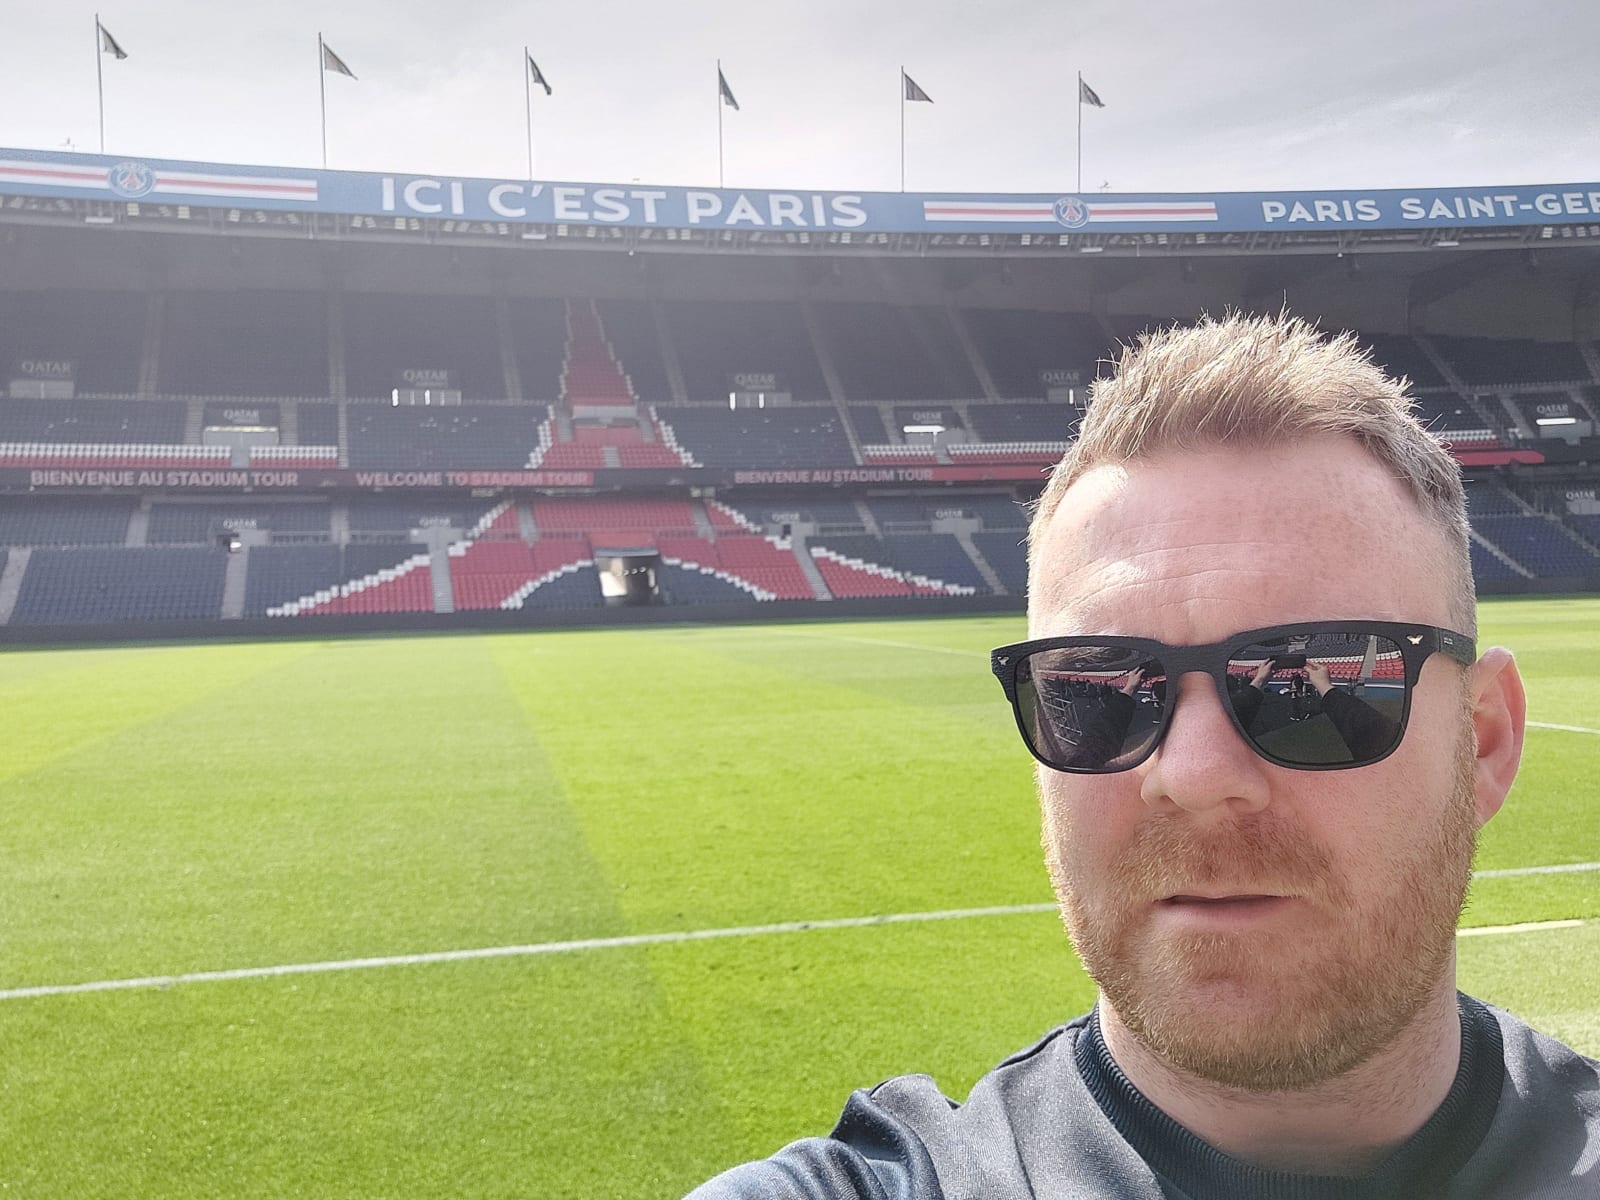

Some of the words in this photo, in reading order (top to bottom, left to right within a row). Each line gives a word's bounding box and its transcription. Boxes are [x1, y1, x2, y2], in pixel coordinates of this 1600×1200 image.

[381, 177, 465, 216] ICI
[686, 191, 869, 228] PARIS
[1262, 198, 1381, 223] PARIS
[31, 471, 135, 486] BIENVENUE
[138, 472, 163, 486] AU
[167, 472, 248, 486] STADIUM
[252, 472, 298, 486] TOUR
[356, 472, 443, 486] WELCOME
[447, 472, 466, 486] TO
[471, 472, 543, 486] STADIUM
[547, 472, 588, 486] TOUR
[735, 470, 809, 484] BIENVENUE
[812, 470, 830, 484] AU
[833, 469, 894, 483] STADIUM
[897, 468, 932, 481] TOUR
